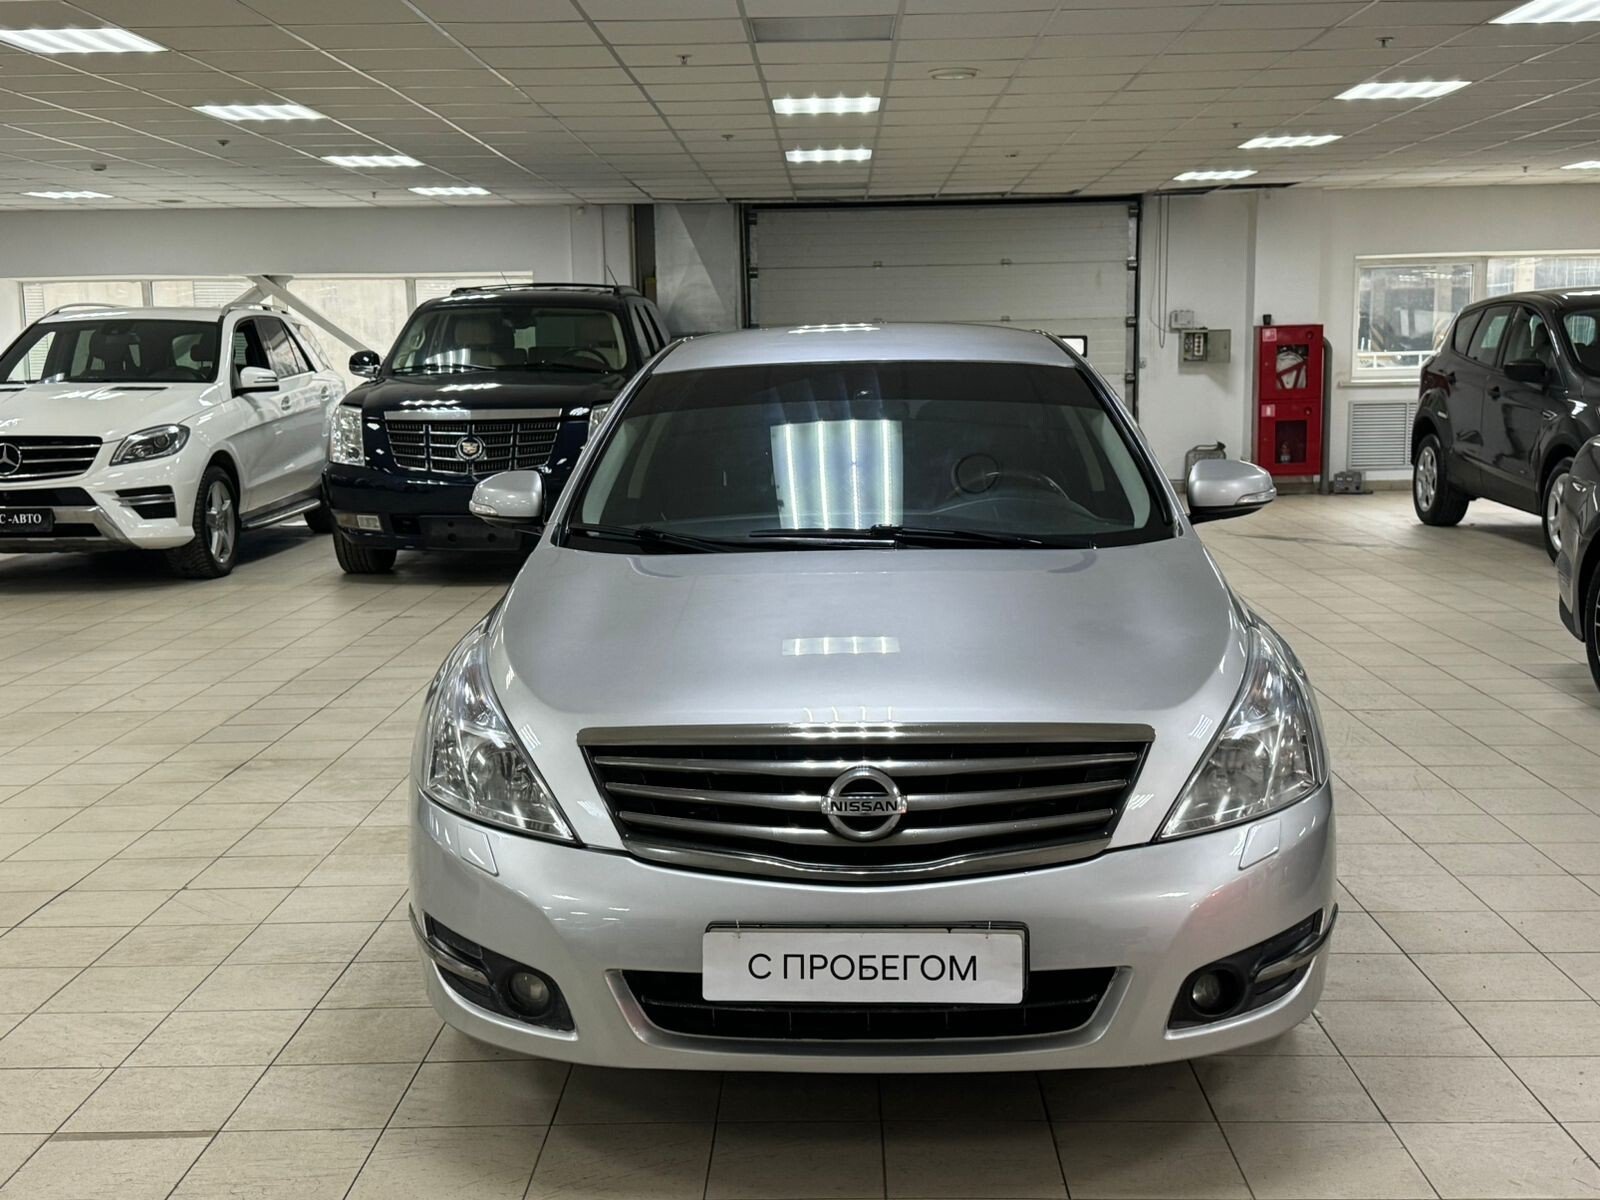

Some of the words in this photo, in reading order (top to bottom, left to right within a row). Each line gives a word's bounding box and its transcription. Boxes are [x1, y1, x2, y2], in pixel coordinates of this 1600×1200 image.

[830, 801, 898, 812] NISSAN
[748, 953, 772, 980] С
[783, 954, 977, 981] ПРОБЕГОМ
